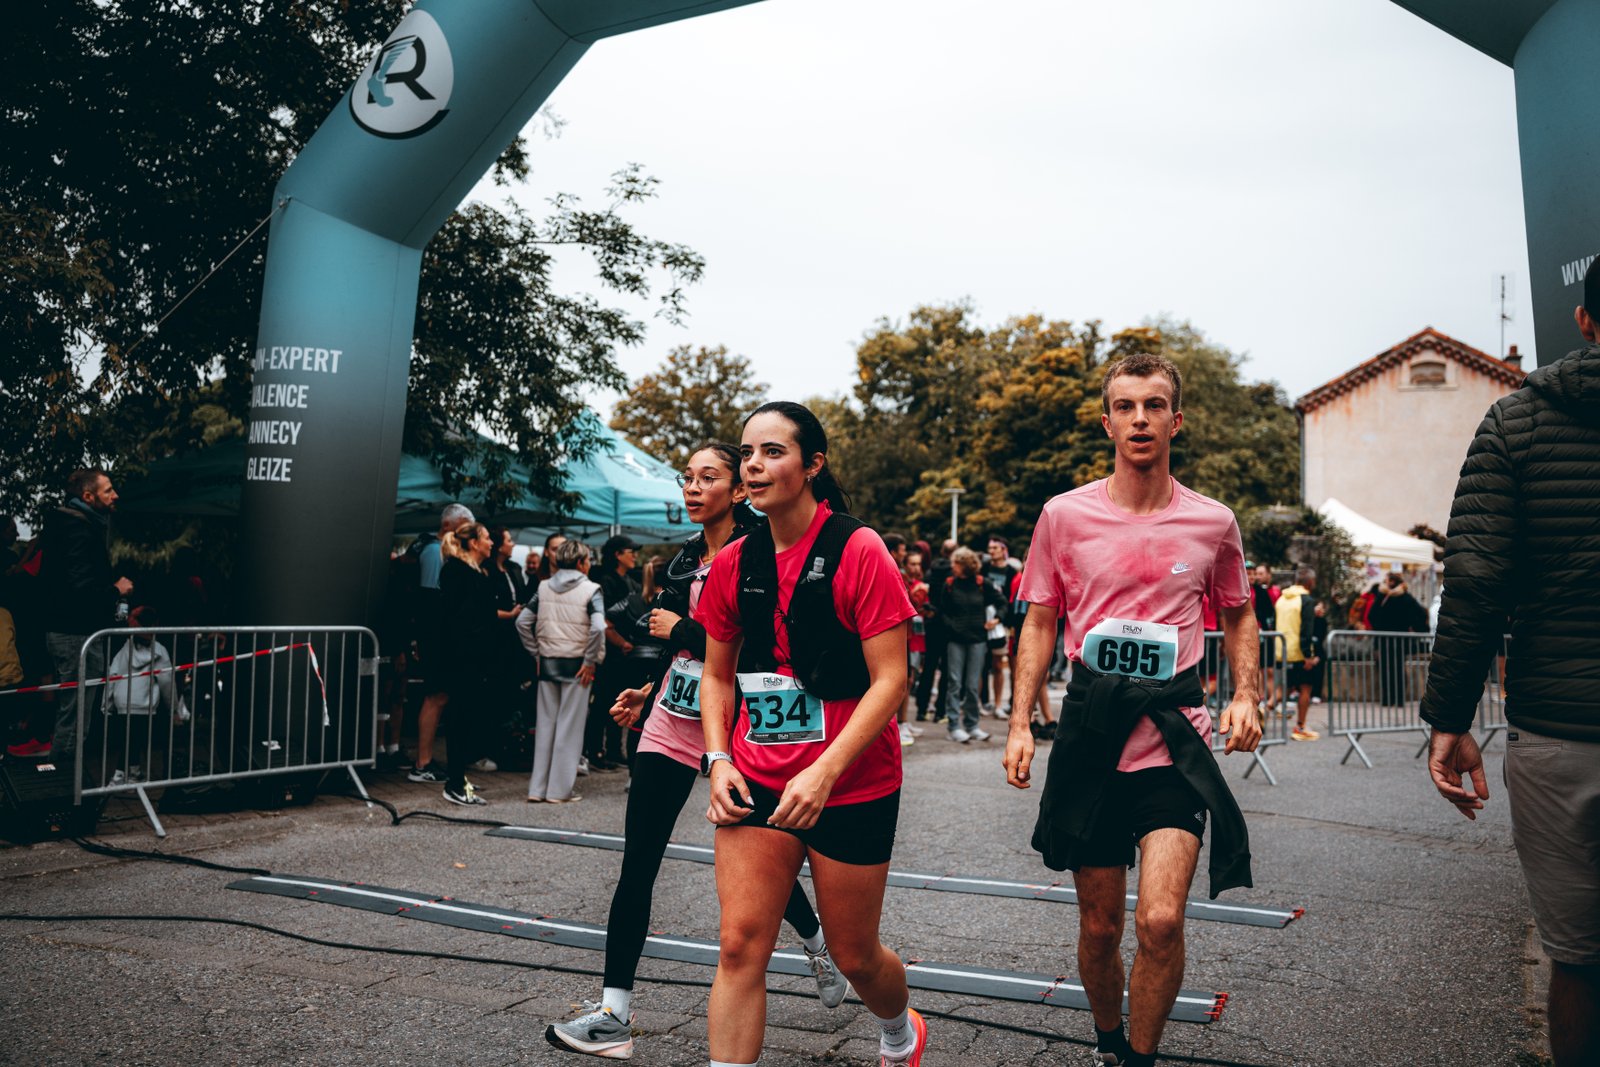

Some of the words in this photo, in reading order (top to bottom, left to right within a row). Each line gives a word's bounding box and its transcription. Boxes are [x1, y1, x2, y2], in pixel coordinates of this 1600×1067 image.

[1561, 254, 1600, 286] WW
[256, 346, 342, 374] N-EXPERT
[248, 420, 302, 445] ANNECY
[247, 457, 292, 482] GLEIZE
[1122, 624, 1143, 632] RUN
[1097, 638, 1160, 677] 695
[670, 674, 700, 707] 94
[745, 693, 811, 730] 534
